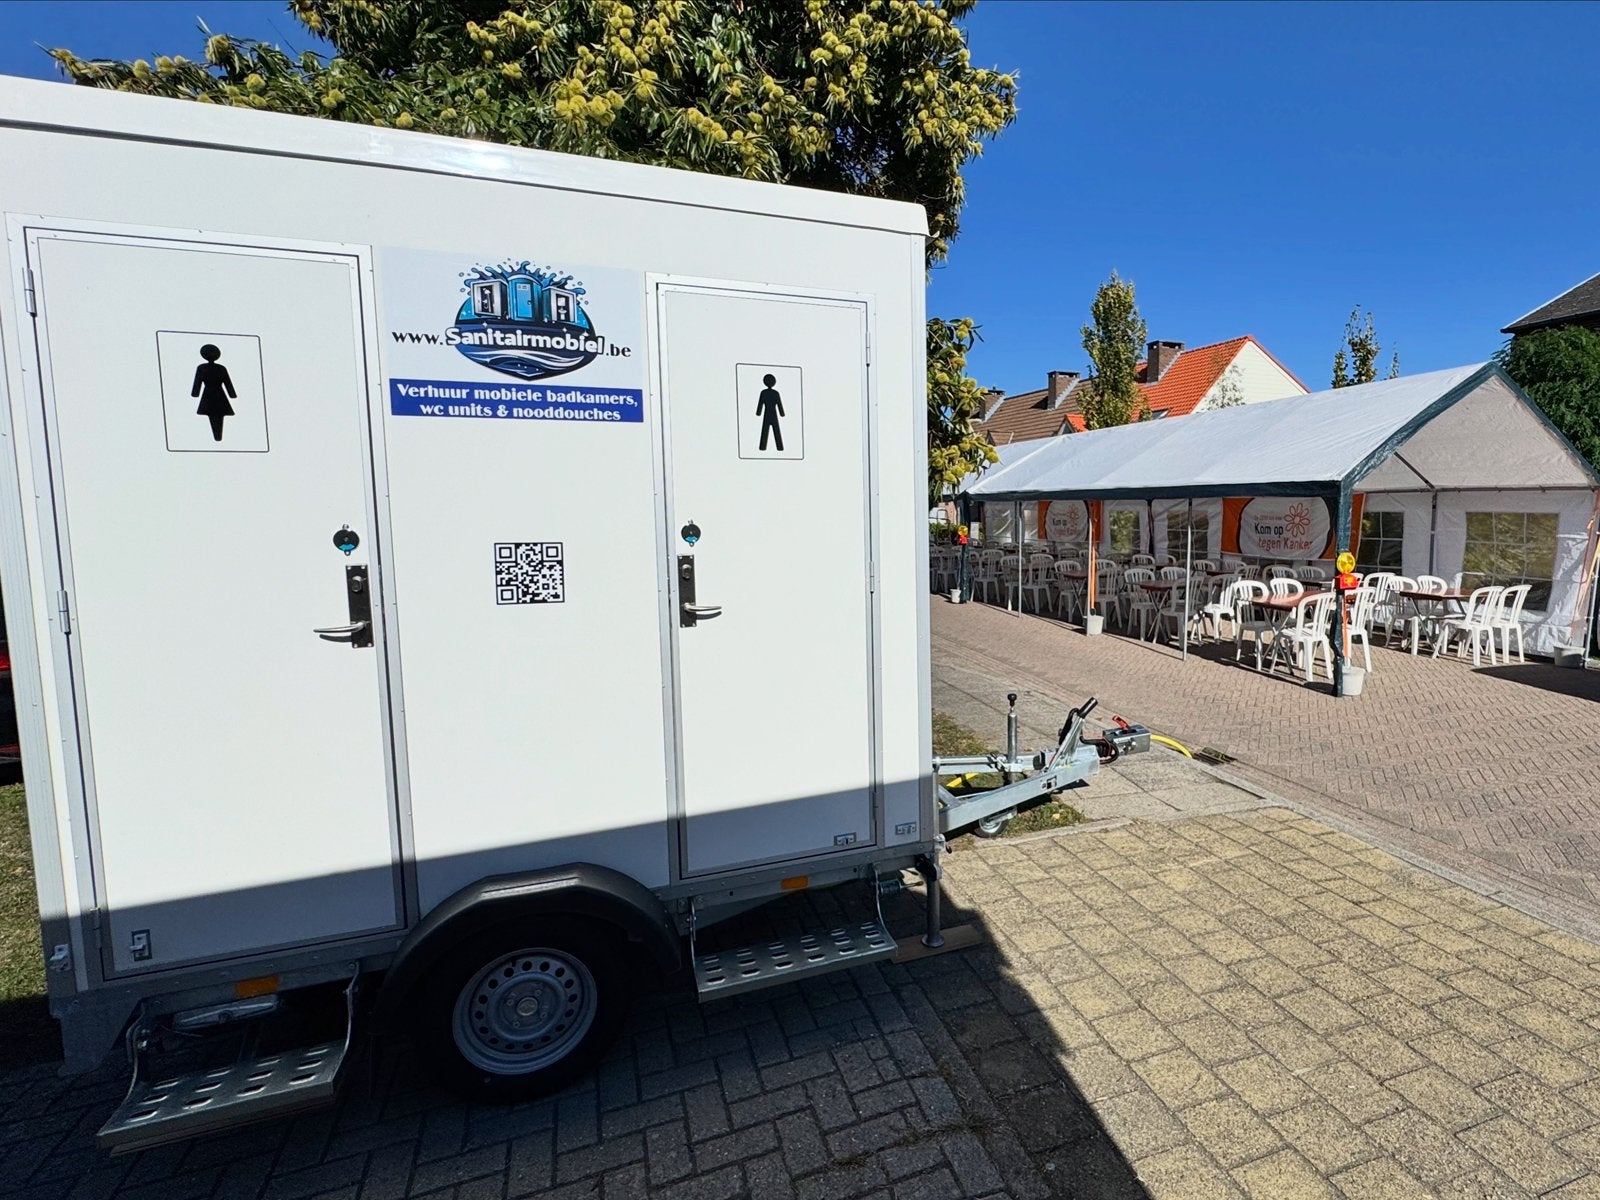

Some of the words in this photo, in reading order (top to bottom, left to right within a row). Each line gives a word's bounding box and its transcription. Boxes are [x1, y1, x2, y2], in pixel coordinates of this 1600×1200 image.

[397, 383, 469, 399] Verhuur
[474, 387, 542, 402] mobiele
[547, 390, 638, 407] badkamers,
[419, 404, 444, 415] wc
[448, 403, 493, 417] units
[496, 404, 509, 418] &
[512, 406, 621, 421] nooddouches
[1255, 523, 1271, 535] Kom
[1274, 526, 1284, 538] op
[1259, 537, 1281, 551] tegen
[1284, 538, 1313, 550] Kanker
